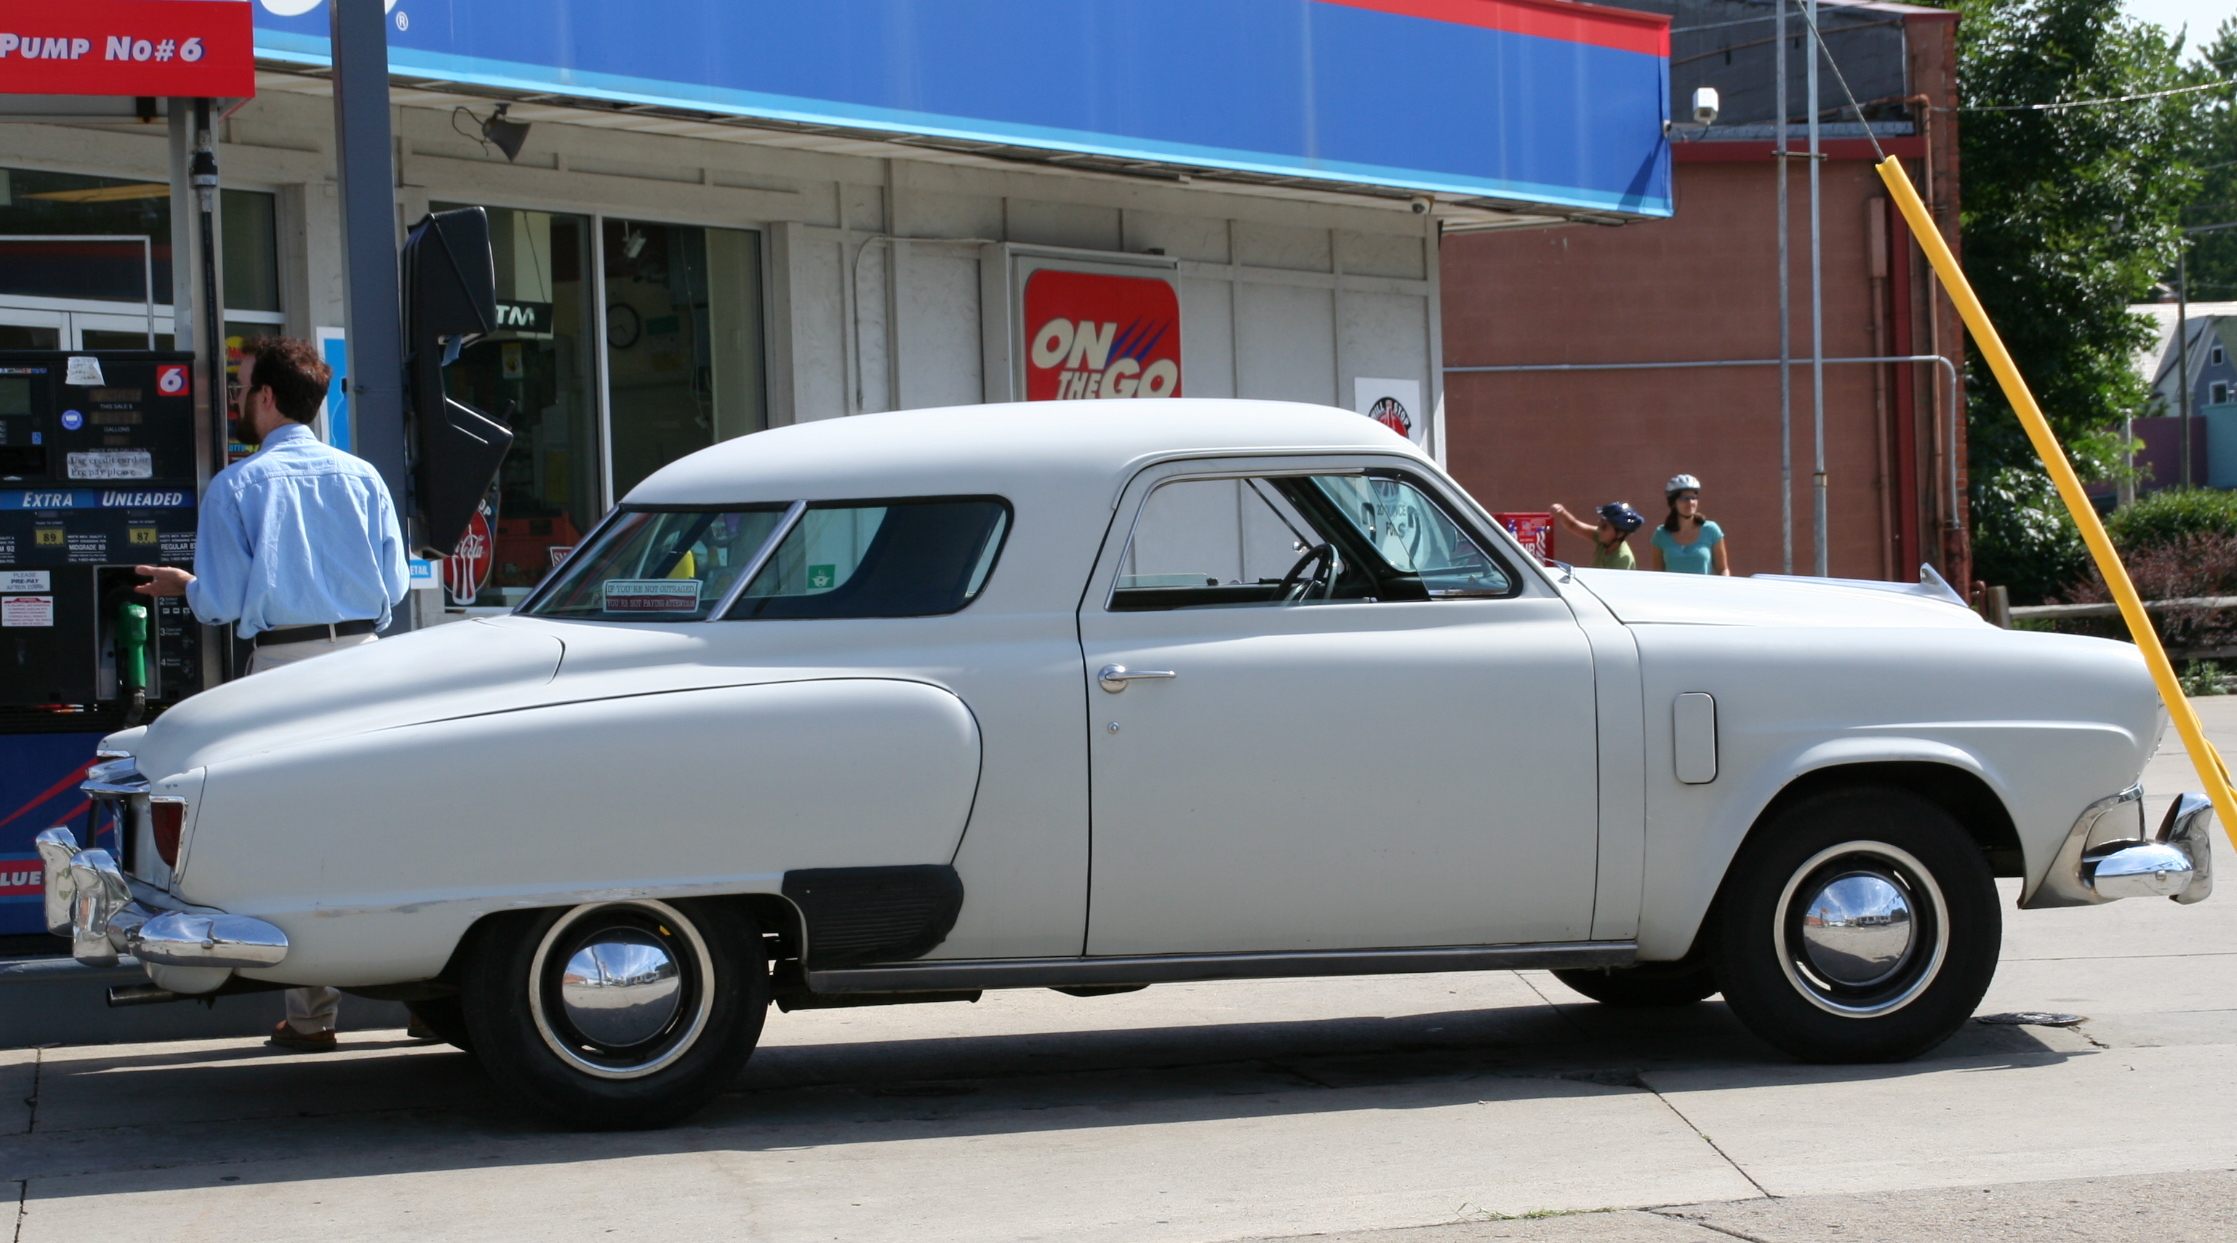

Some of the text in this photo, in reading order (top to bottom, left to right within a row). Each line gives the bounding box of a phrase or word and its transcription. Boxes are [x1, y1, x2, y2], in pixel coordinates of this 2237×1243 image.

[0, 33, 90, 60] PUMP
[1031, 318, 1118, 370] ON
[160, 368, 182, 392] 6
[1056, 358, 1178, 400] THE GO
[89, 456, 115, 464] credit
[22, 491, 183, 507] EXTRA UNLEADED
[43, 533, 57, 543] 89
[137, 532, 149, 542] 87
[645, 585, 658, 593] NOT
[0, 871, 42, 886] LUE
